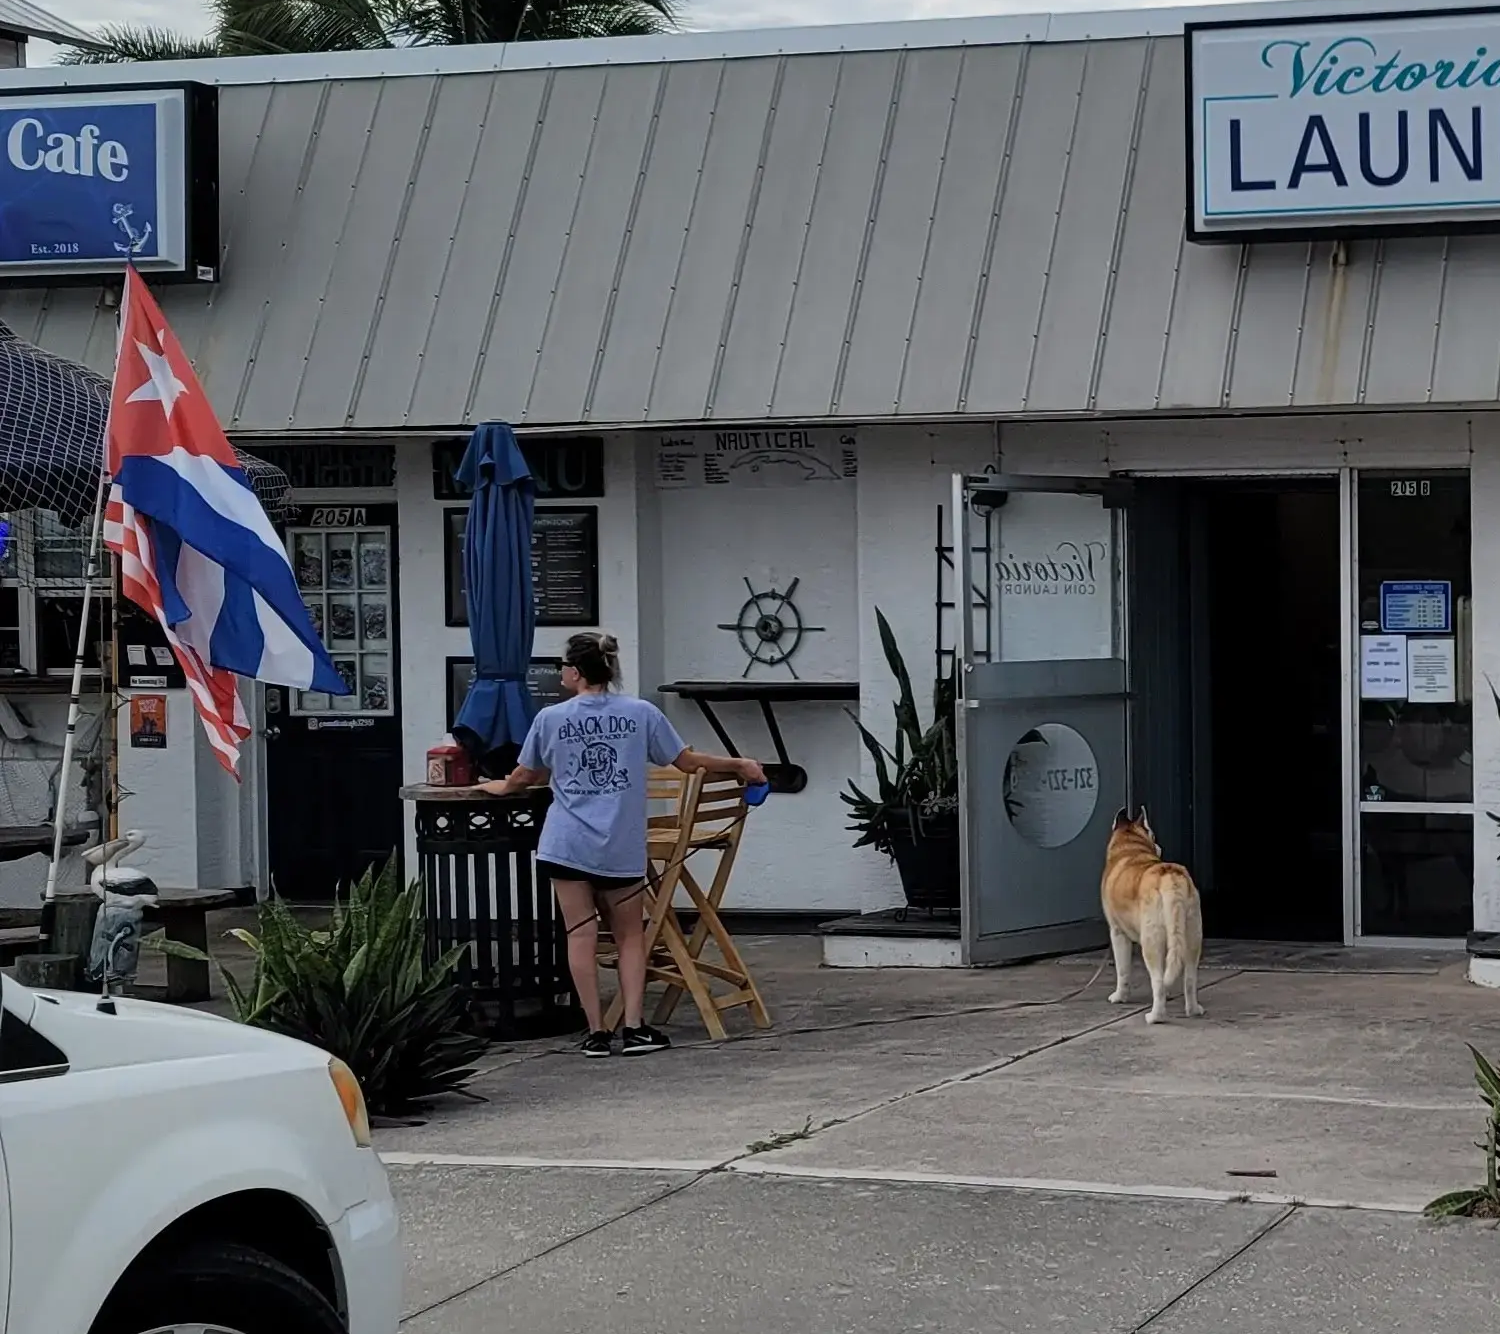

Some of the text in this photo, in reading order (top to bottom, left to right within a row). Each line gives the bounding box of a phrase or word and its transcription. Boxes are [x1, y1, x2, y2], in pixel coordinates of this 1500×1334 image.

[7, 118, 129, 182] Cafe
[31, 243, 79, 254] Est. 2018
[716, 432, 815, 451] NAUTICAL
[440, 447, 588, 494] MNU
[1391, 481, 1430, 496] 205 B
[311, 508, 365, 526] 205 A
[609, 715, 636, 734] DOG
